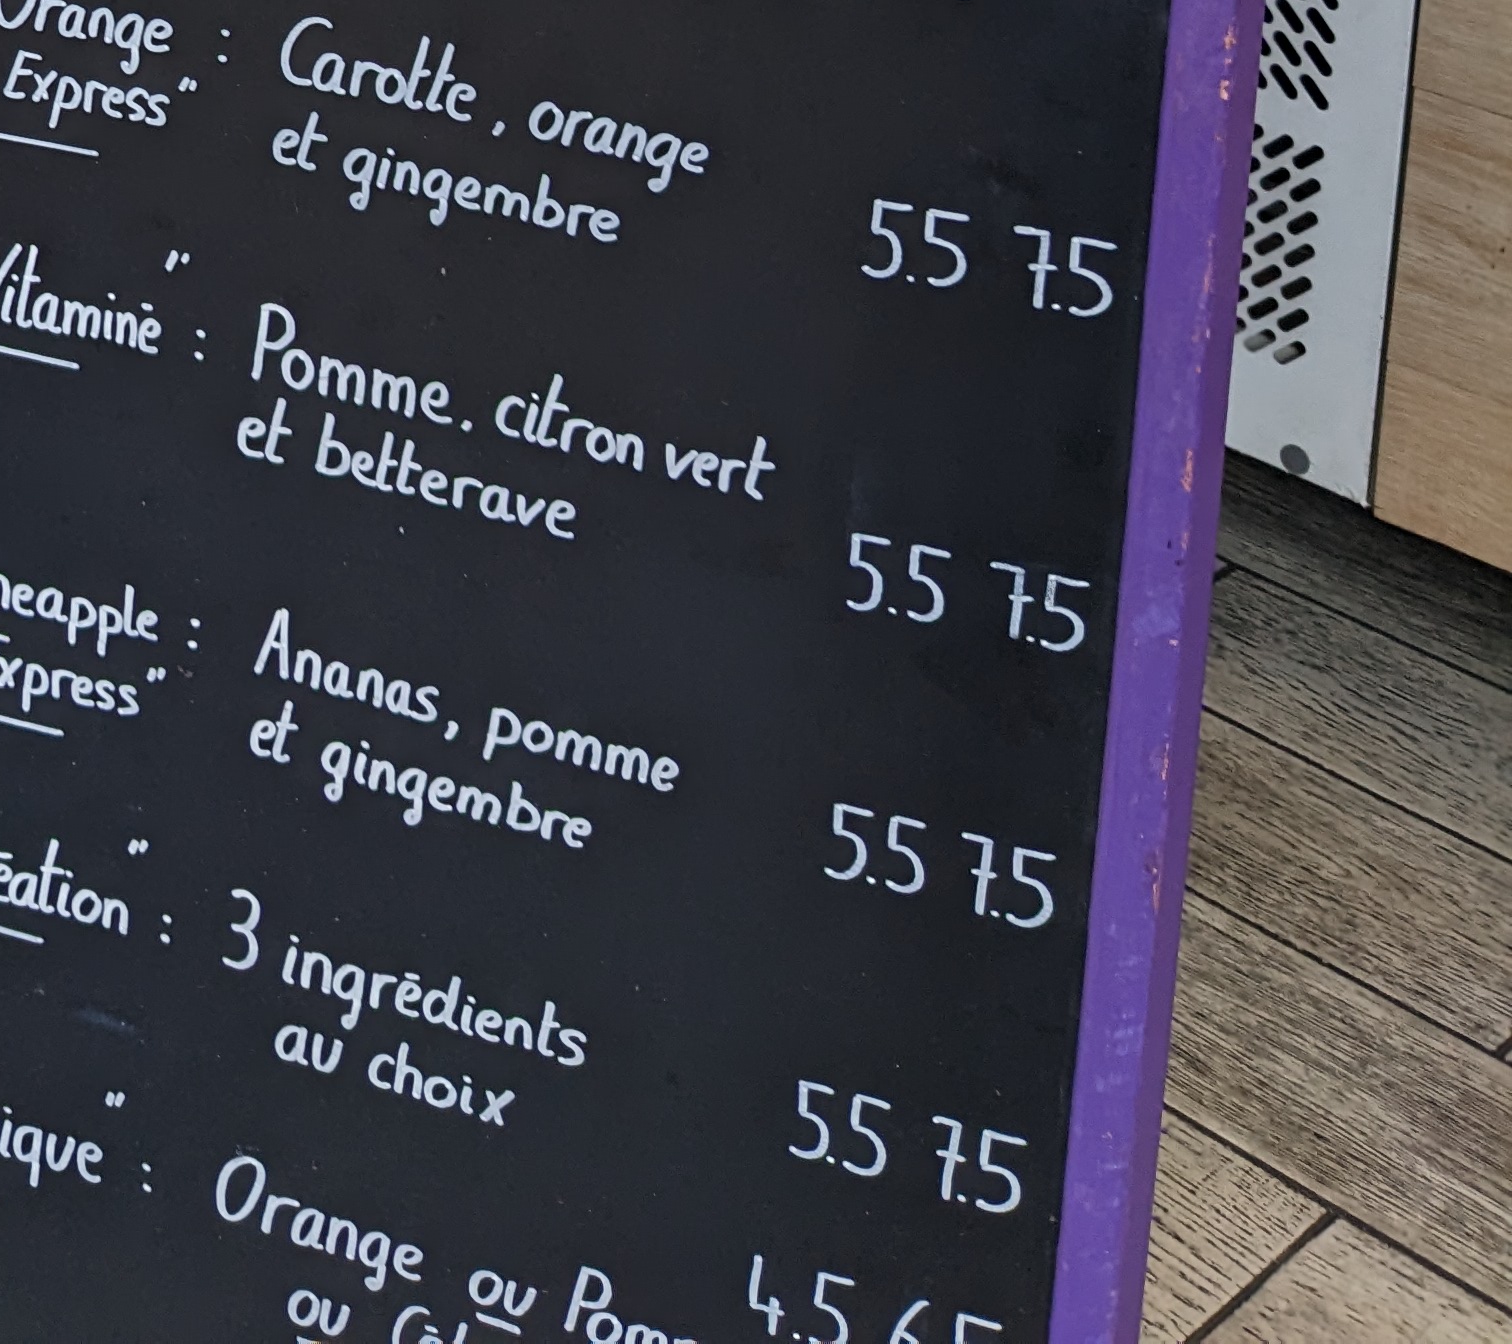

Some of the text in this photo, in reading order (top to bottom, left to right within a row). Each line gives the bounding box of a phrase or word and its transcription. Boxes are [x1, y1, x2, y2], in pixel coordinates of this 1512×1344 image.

[272, 111, 621, 242] et gingembre
[528, 100, 710, 195] orange
[236, 397, 578, 542] et betterave
[494, 373, 644, 472] citron
[665, 435, 776, 501] vert
[253, 608, 459, 741] Ananas,
[482, 706, 681, 793] pomme
[249, 699, 594, 850] et gingembre
[221, 888, 261, 971] 3
[280, 934, 588, 1068] ingrédients
[274, 1024, 516, 1127] au choix
[215, 1155, 424, 1292] Orange
[468, 1269, 538, 1317] ou
